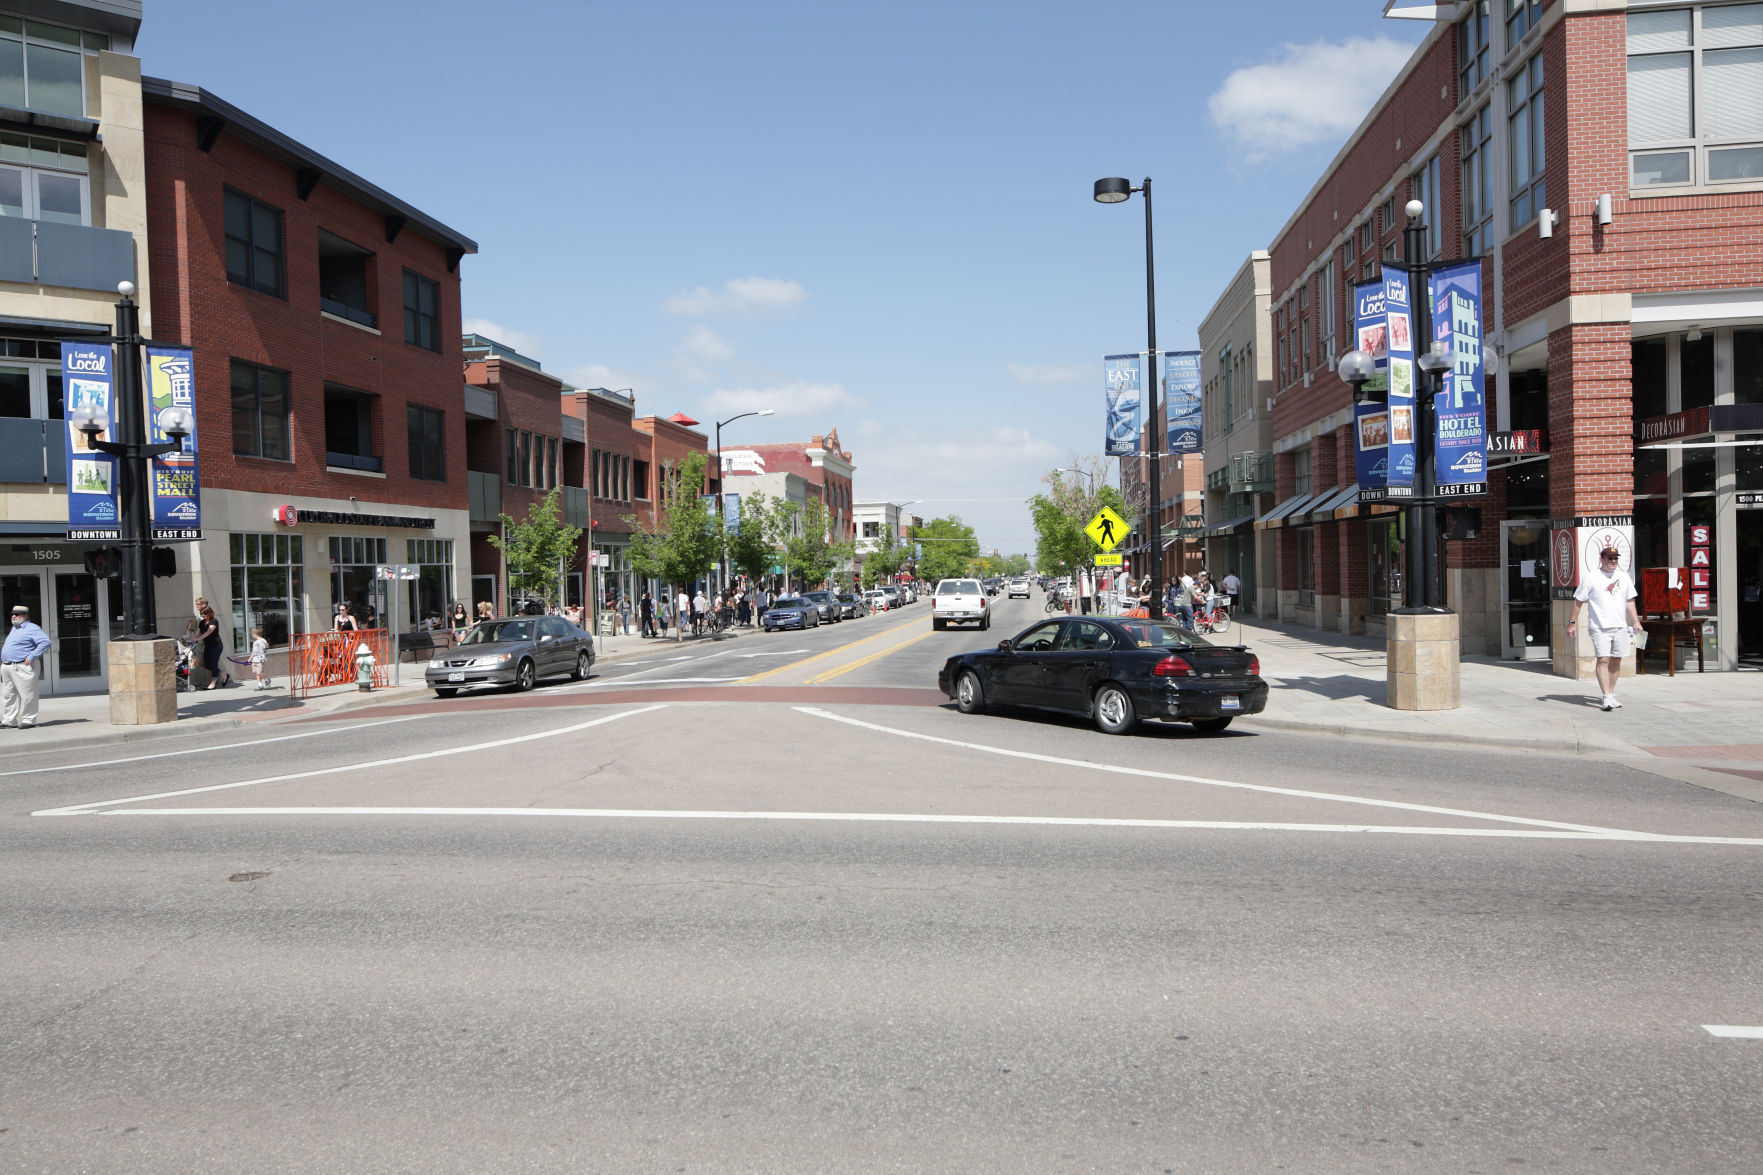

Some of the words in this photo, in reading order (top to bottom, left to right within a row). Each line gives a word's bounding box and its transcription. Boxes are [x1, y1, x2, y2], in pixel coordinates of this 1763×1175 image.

[1387, 281, 1407, 303] Local
[68, 353, 106, 372] Local
[1108, 369, 1138, 382] EAST
[1439, 416, 1482, 430] HOTEL
[1439, 428, 1482, 439] BOULDERADO
[1486, 433, 1524, 450] ASIAN
[156, 473, 196, 482] PEARL
[1440, 485, 1460, 495] EAST
[1464, 484, 1481, 493] END
[1582, 517, 1632, 527] DECORASIAN
[71, 531, 118, 539] DOWNTOWN
[32, 550, 61, 560] 1505
[1692, 529, 1709, 607] SALE
